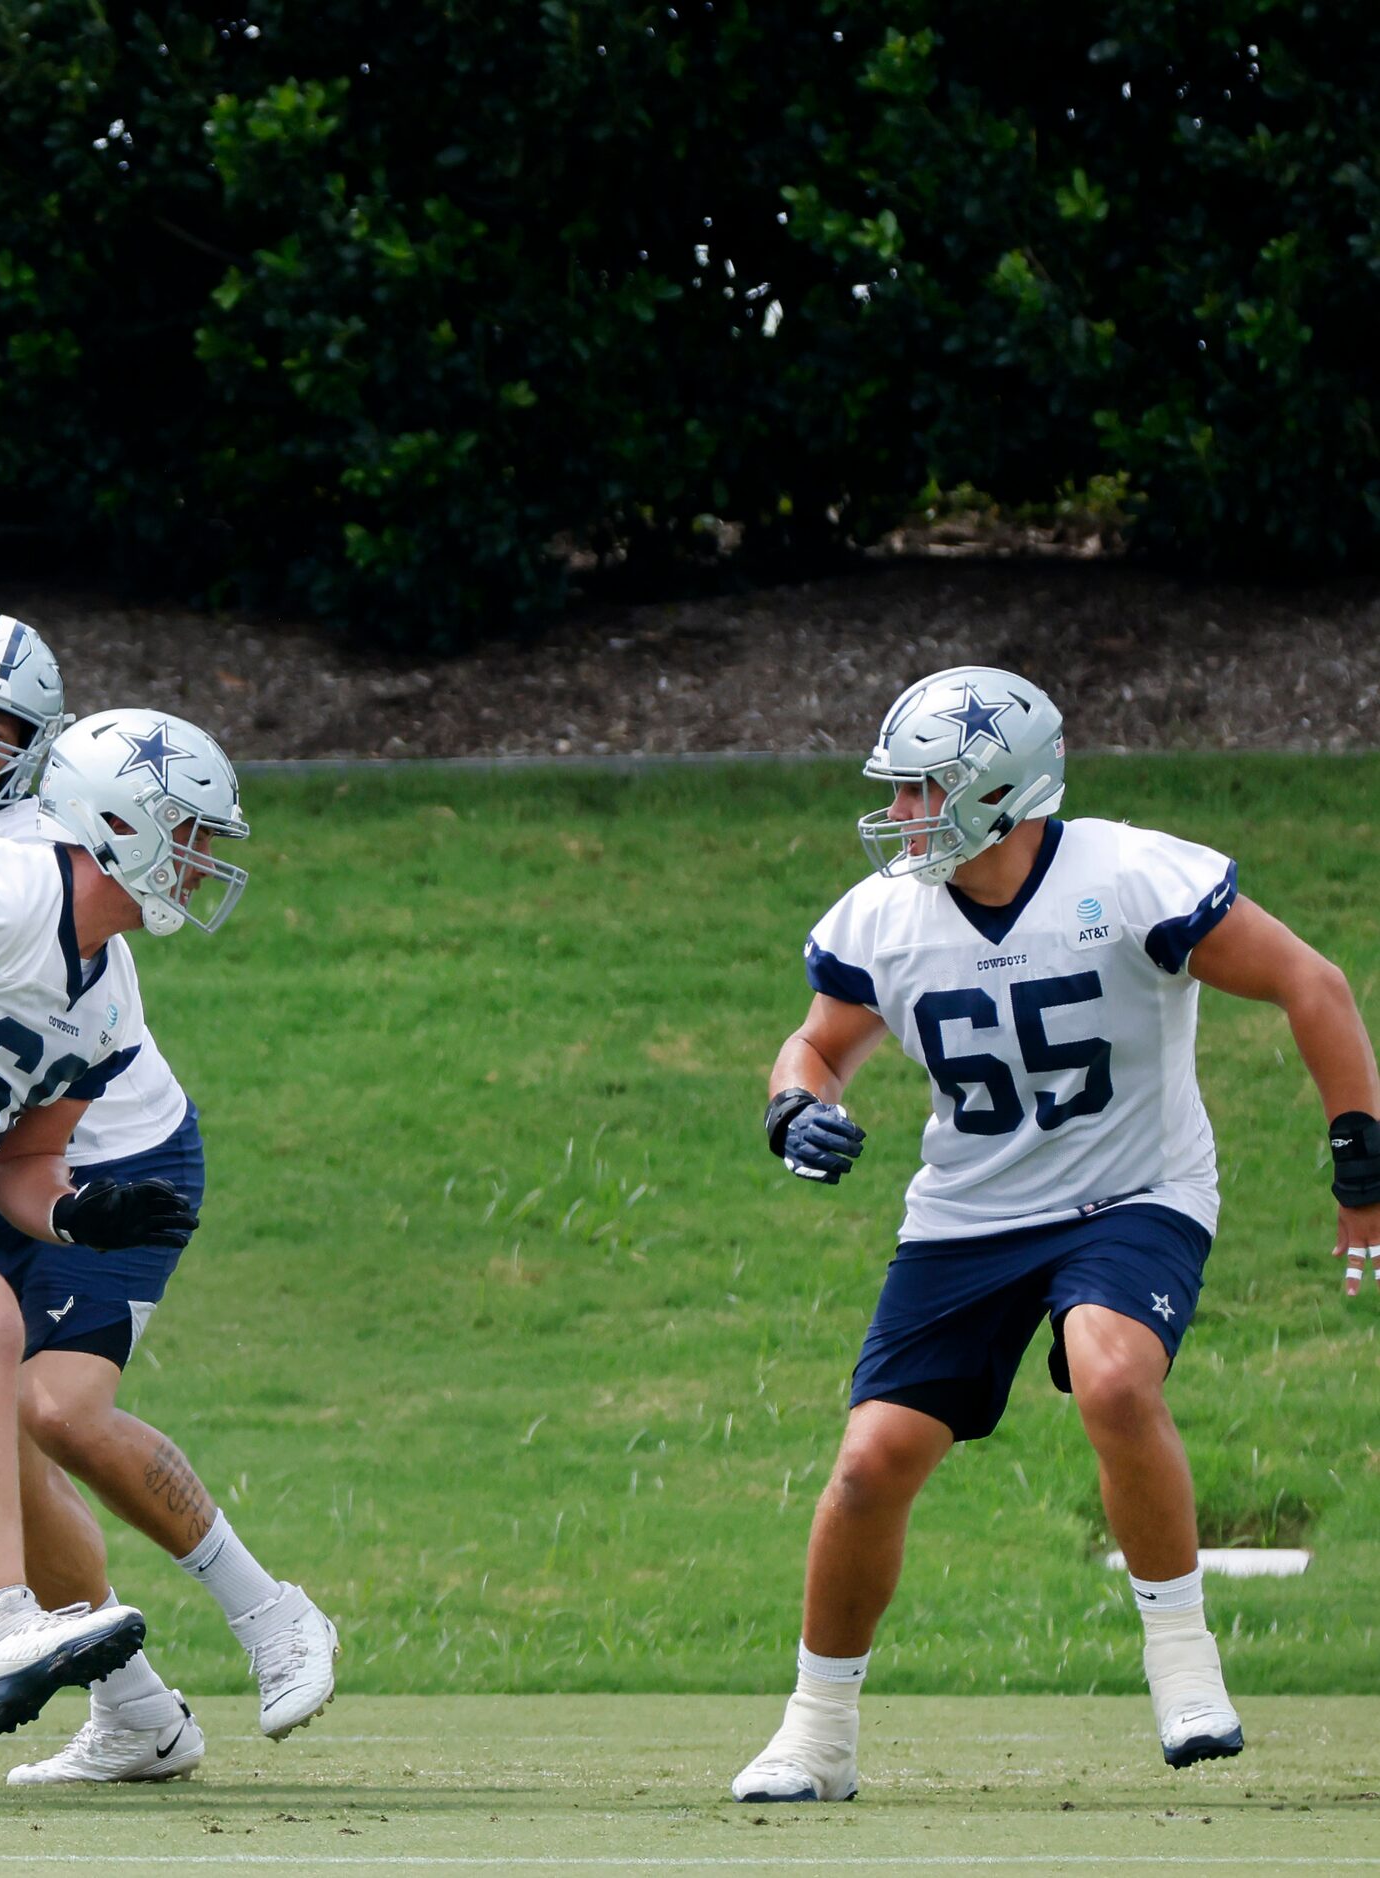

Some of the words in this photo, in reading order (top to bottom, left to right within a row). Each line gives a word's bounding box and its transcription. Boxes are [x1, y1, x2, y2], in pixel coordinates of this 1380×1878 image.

[1078, 924, 1109, 942] AT&T
[976, 954, 1028, 971] COWBOYS
[48, 1015, 80, 1037] COWBOYS
[99, 1030, 113, 1048] T&T
[913, 969, 1114, 1136] 65
